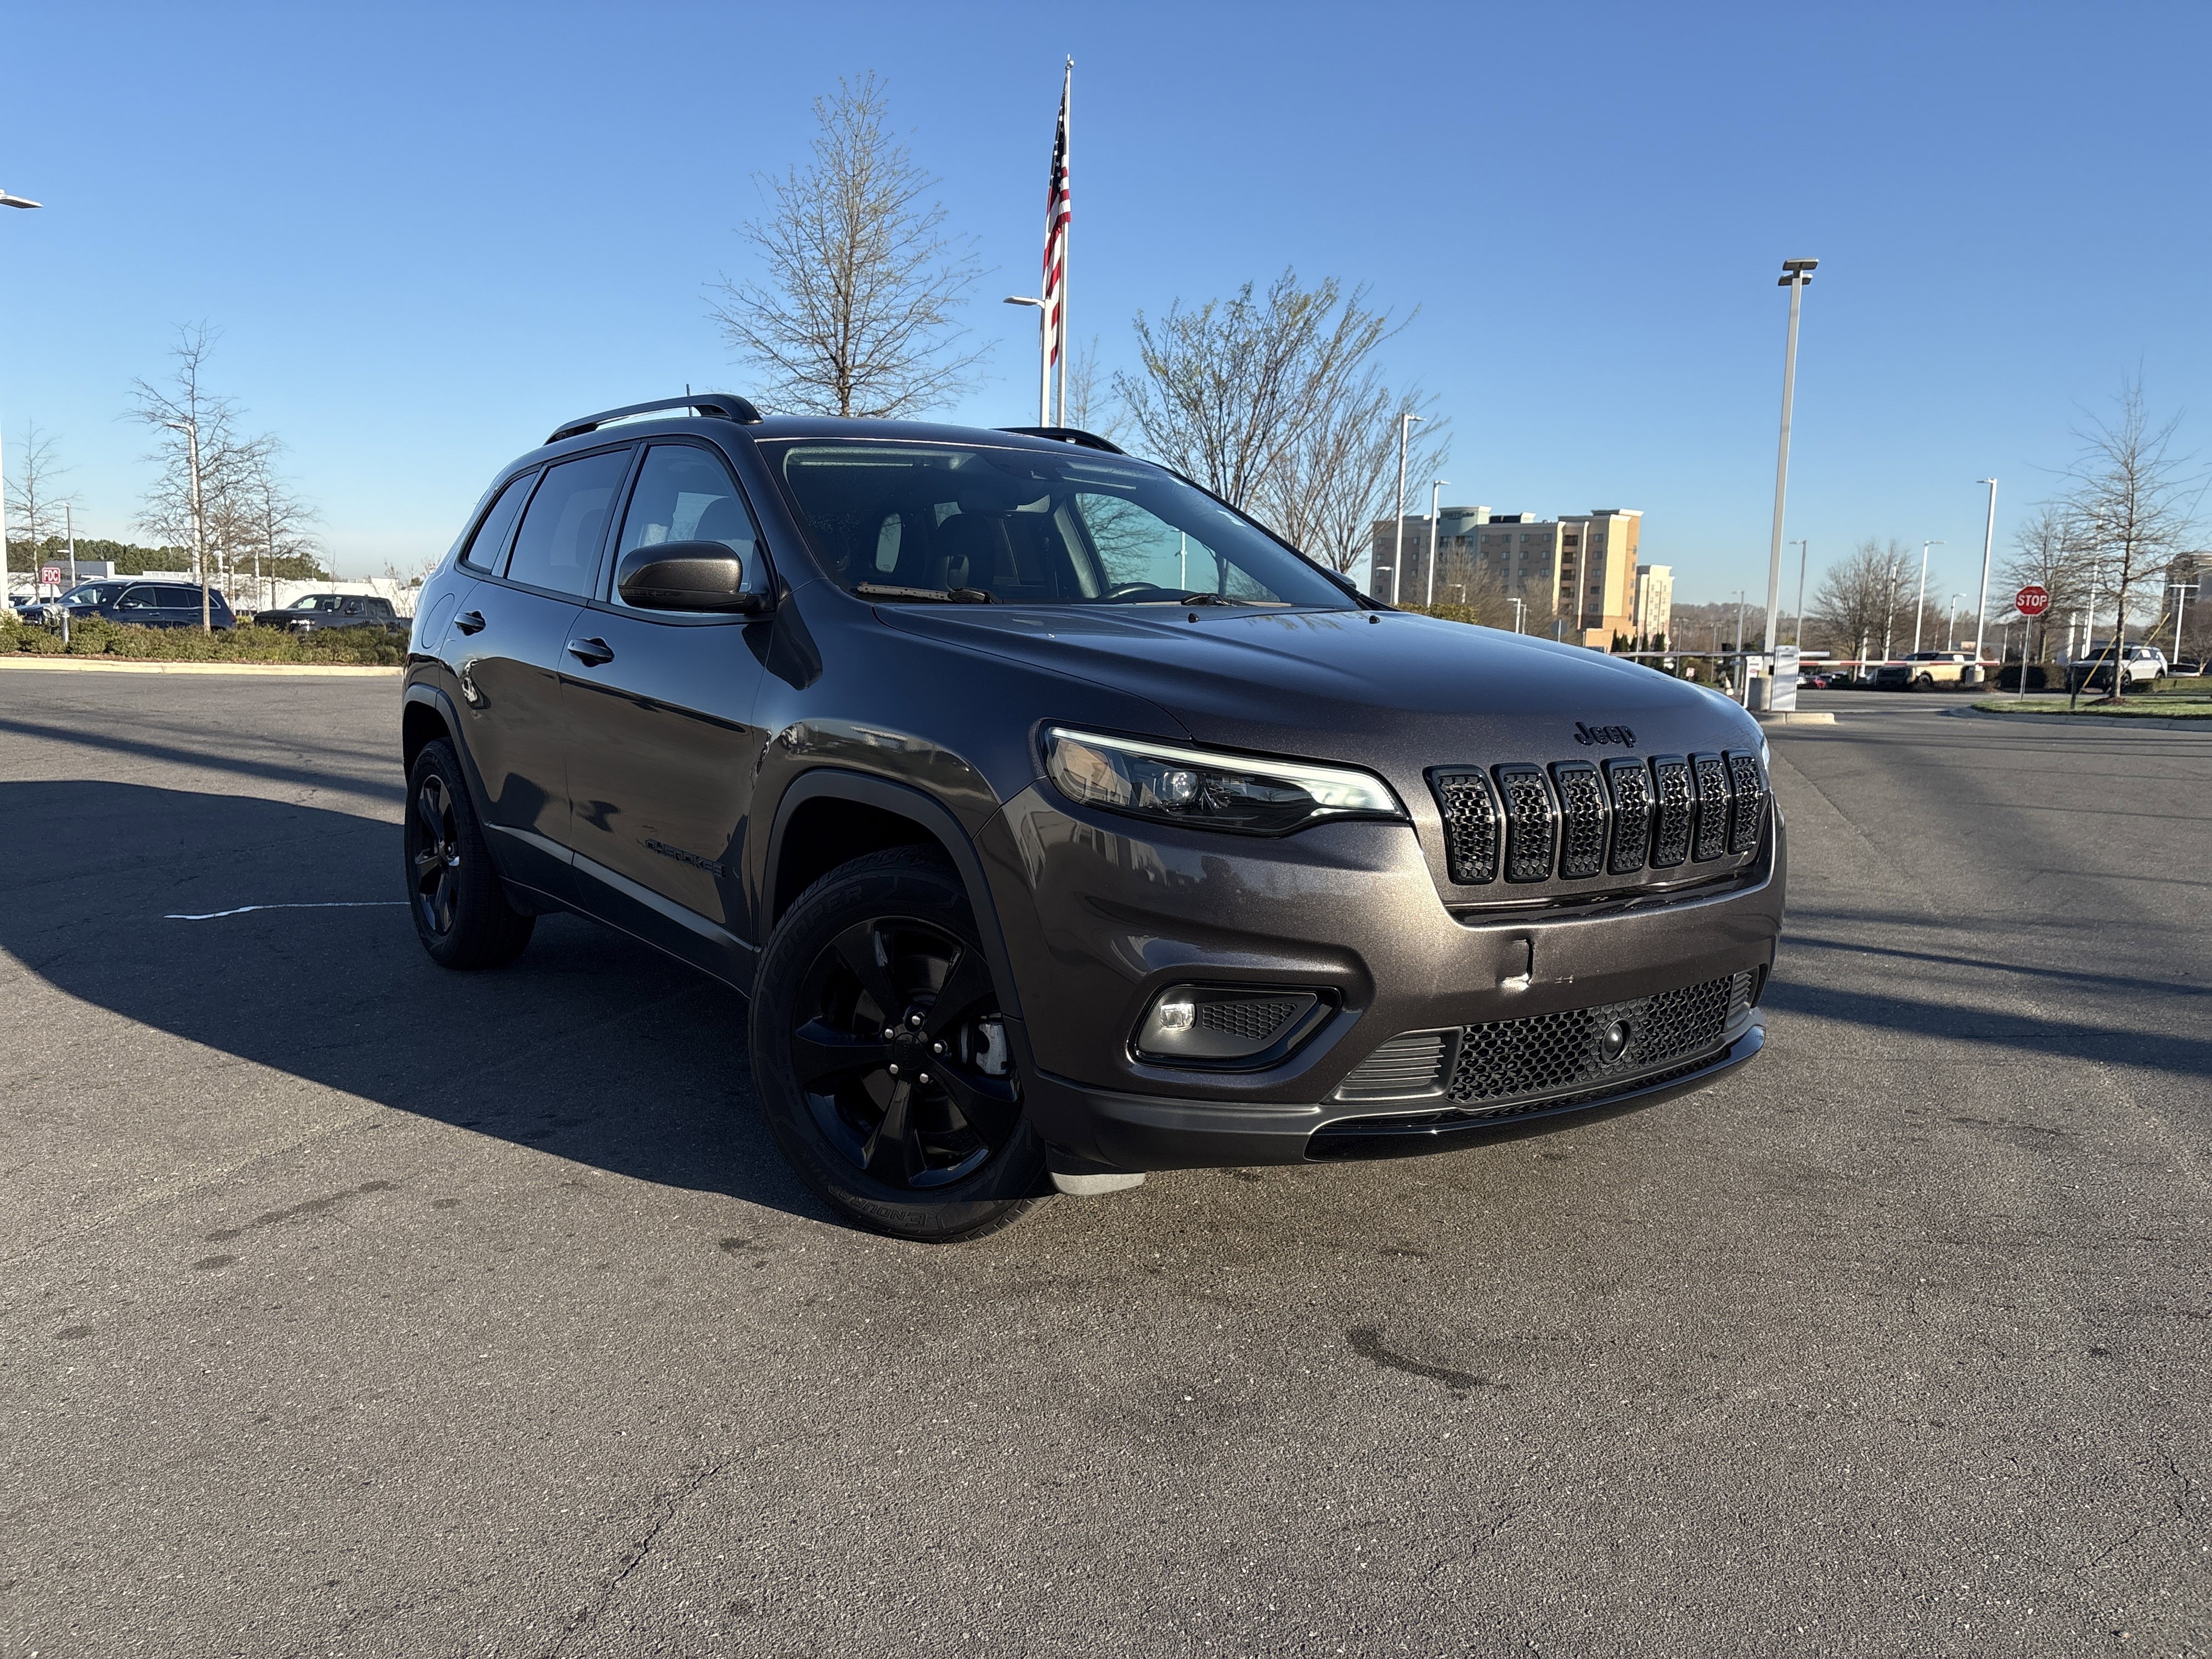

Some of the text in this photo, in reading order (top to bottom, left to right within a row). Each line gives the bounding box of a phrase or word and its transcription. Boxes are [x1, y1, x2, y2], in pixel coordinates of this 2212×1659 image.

[44, 569, 58, 582] FDC
[2017, 594, 2047, 607] STOP
[1573, 721, 1637, 748] Jeep
[645, 838, 726, 879] CHEROKEE
[769, 884, 863, 984] COOPER
